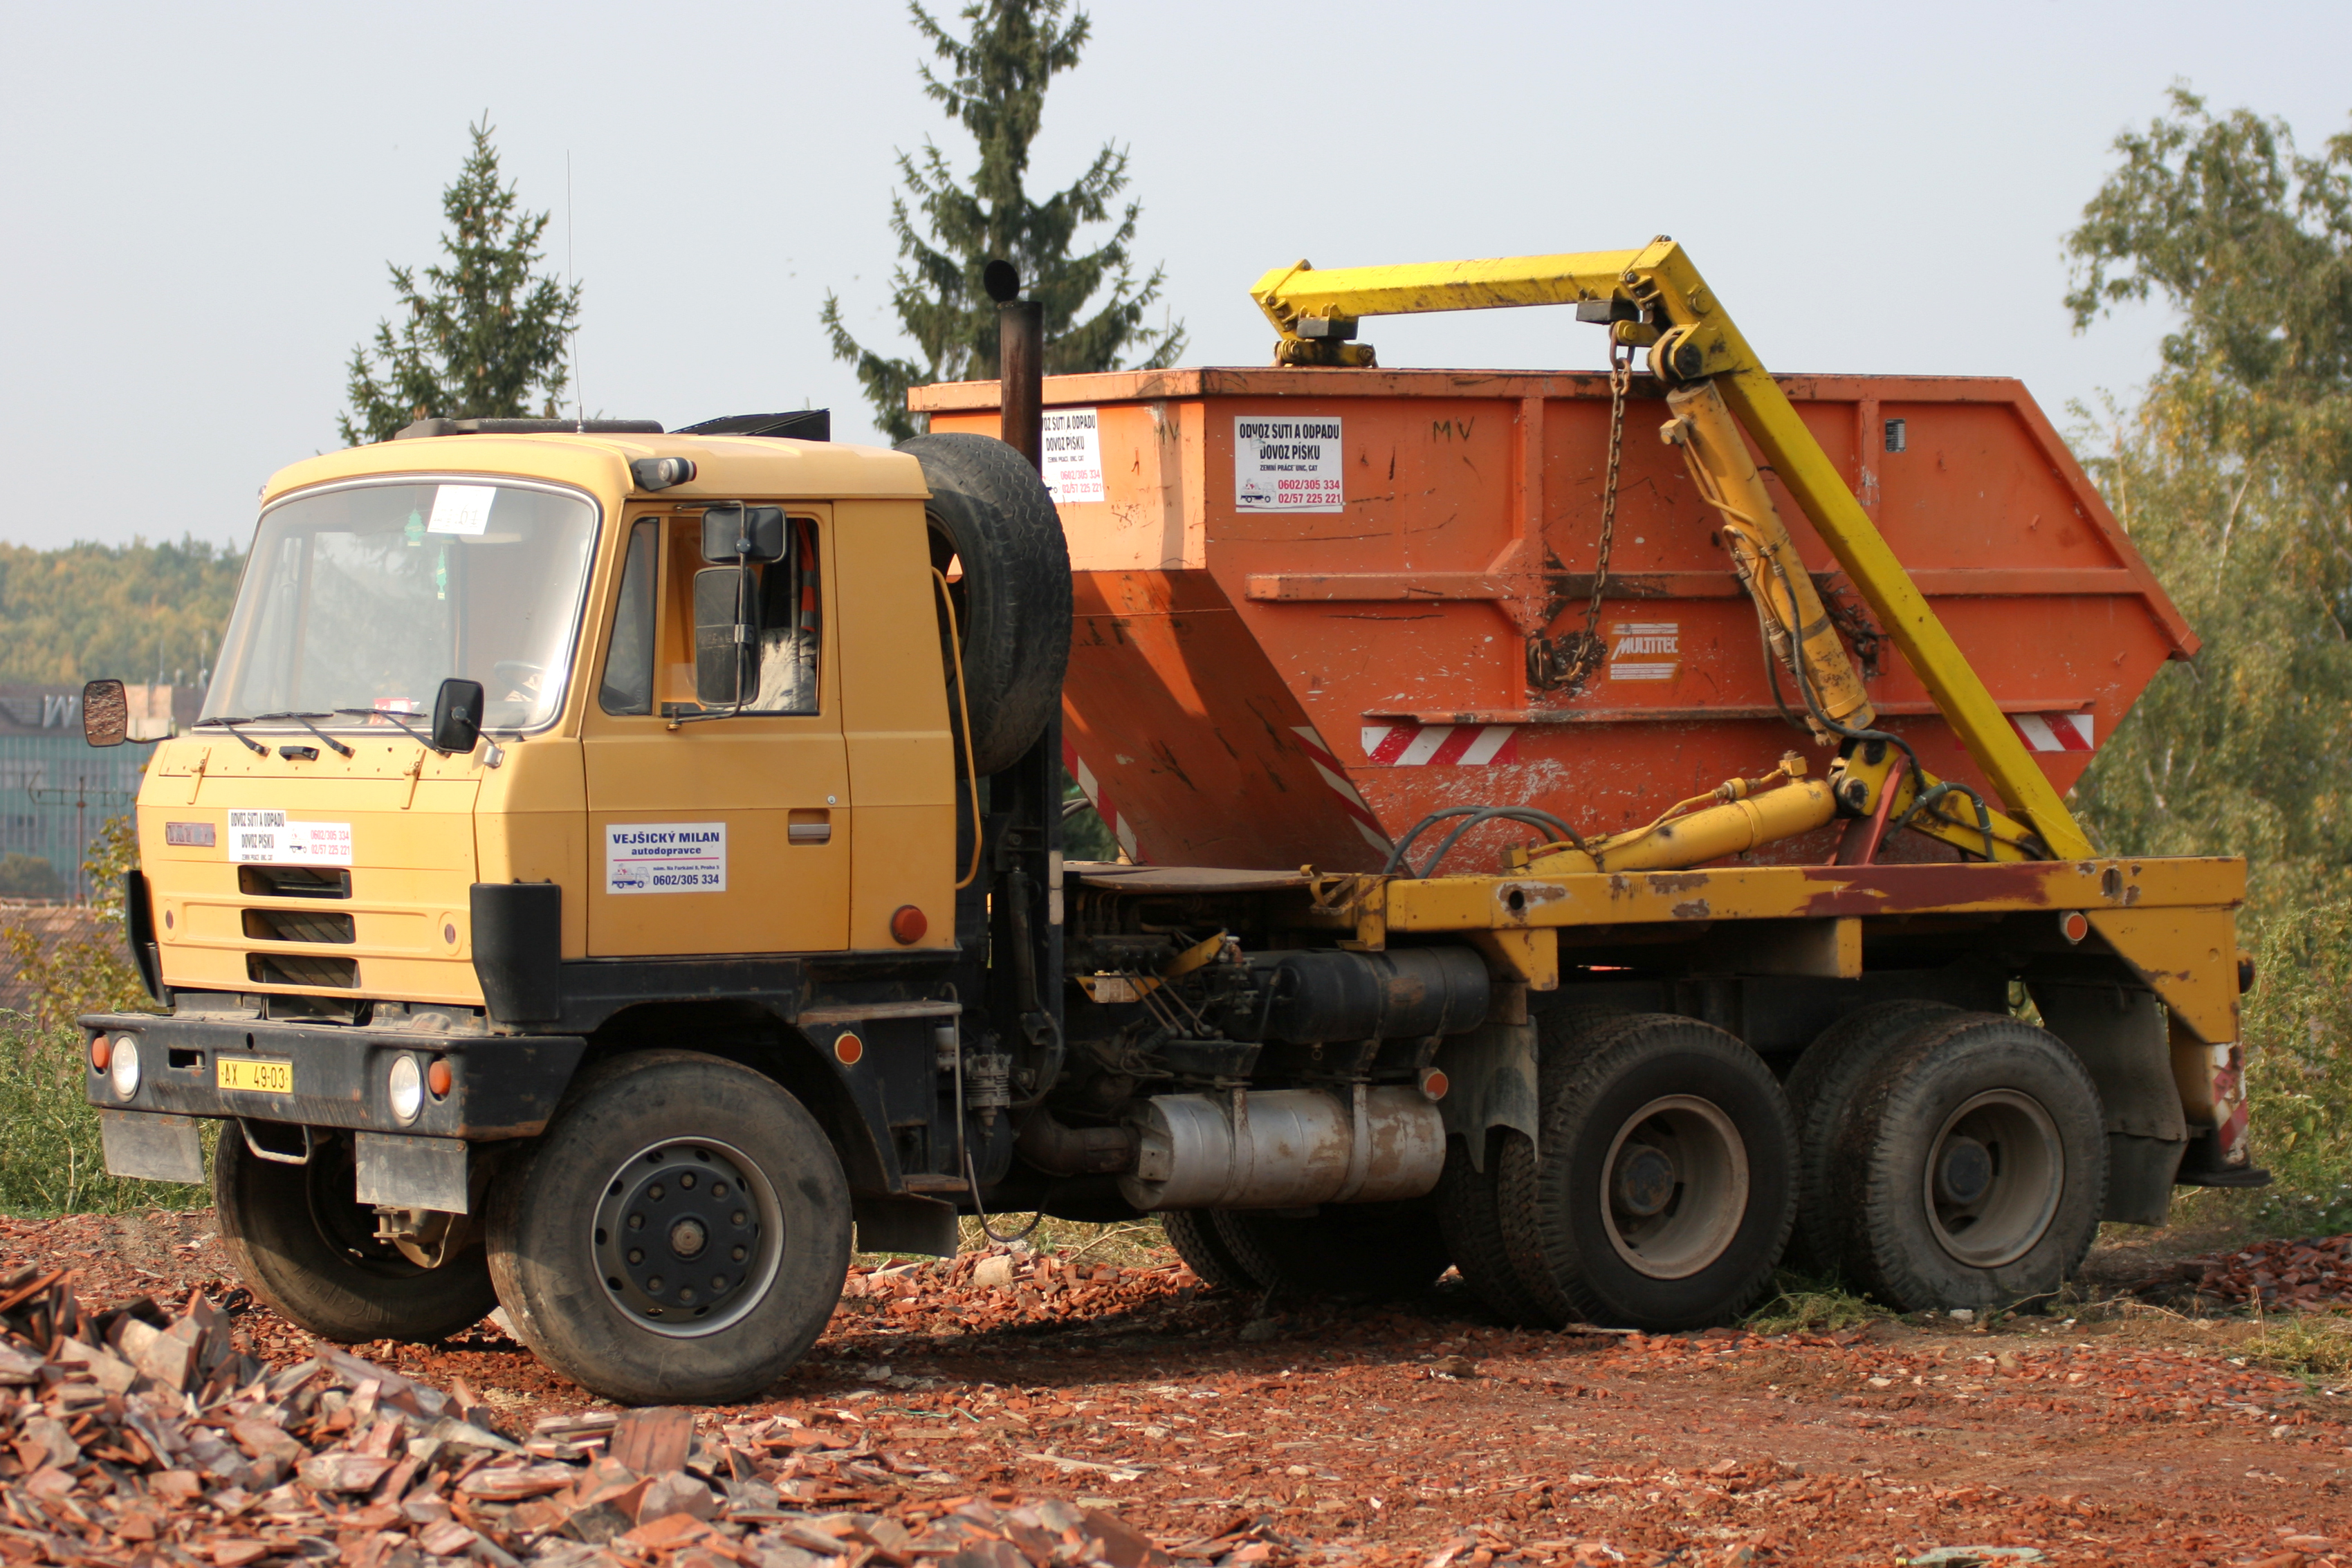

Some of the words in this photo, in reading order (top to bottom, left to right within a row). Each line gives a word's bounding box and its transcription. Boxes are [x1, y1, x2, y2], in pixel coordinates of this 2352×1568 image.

[1067, 416, 1070, 430] A
[1072, 414, 1095, 429] ODPADU
[1240, 423, 1270, 439] ODVOZ
[1272, 423, 1292, 439] SUTI
[1295, 424, 1300, 439] A
[1303, 423, 1339, 439] ODPADU
[1046, 436, 1065, 451] DOVOZ
[1260, 444, 1290, 459] DOVOZ
[1292, 441, 1320, 460] PÍSKU
[1060, 470, 1087, 480] 0602/305
[1090, 469, 1100, 479] 334
[1080, 483, 1090, 492] 225
[1092, 483, 1101, 492] 221
[1278, 480, 1320, 490] 0602/305
[1324, 480, 1340, 489] 334
[1278, 494, 1303, 503] 02/57
[1307, 494, 1322, 503] 225
[1325, 494, 1341, 503] 221
[1610, 636, 1678, 661] MULTITEC
[259, 812, 263, 827] A
[311, 830, 336, 840] 0602/305
[339, 831, 349, 840] 334
[613, 831, 677, 844] VEJŠICKÝ
[679, 833, 719, 842] MILAN
[329, 845, 338, 854] 225
[340, 845, 349, 855] 221
[632, 847, 701, 856] autodopravce
[654, 875, 699, 885] 0602/305
[702, 874, 719, 884] 334
[226, 1063, 238, 1085] AX
